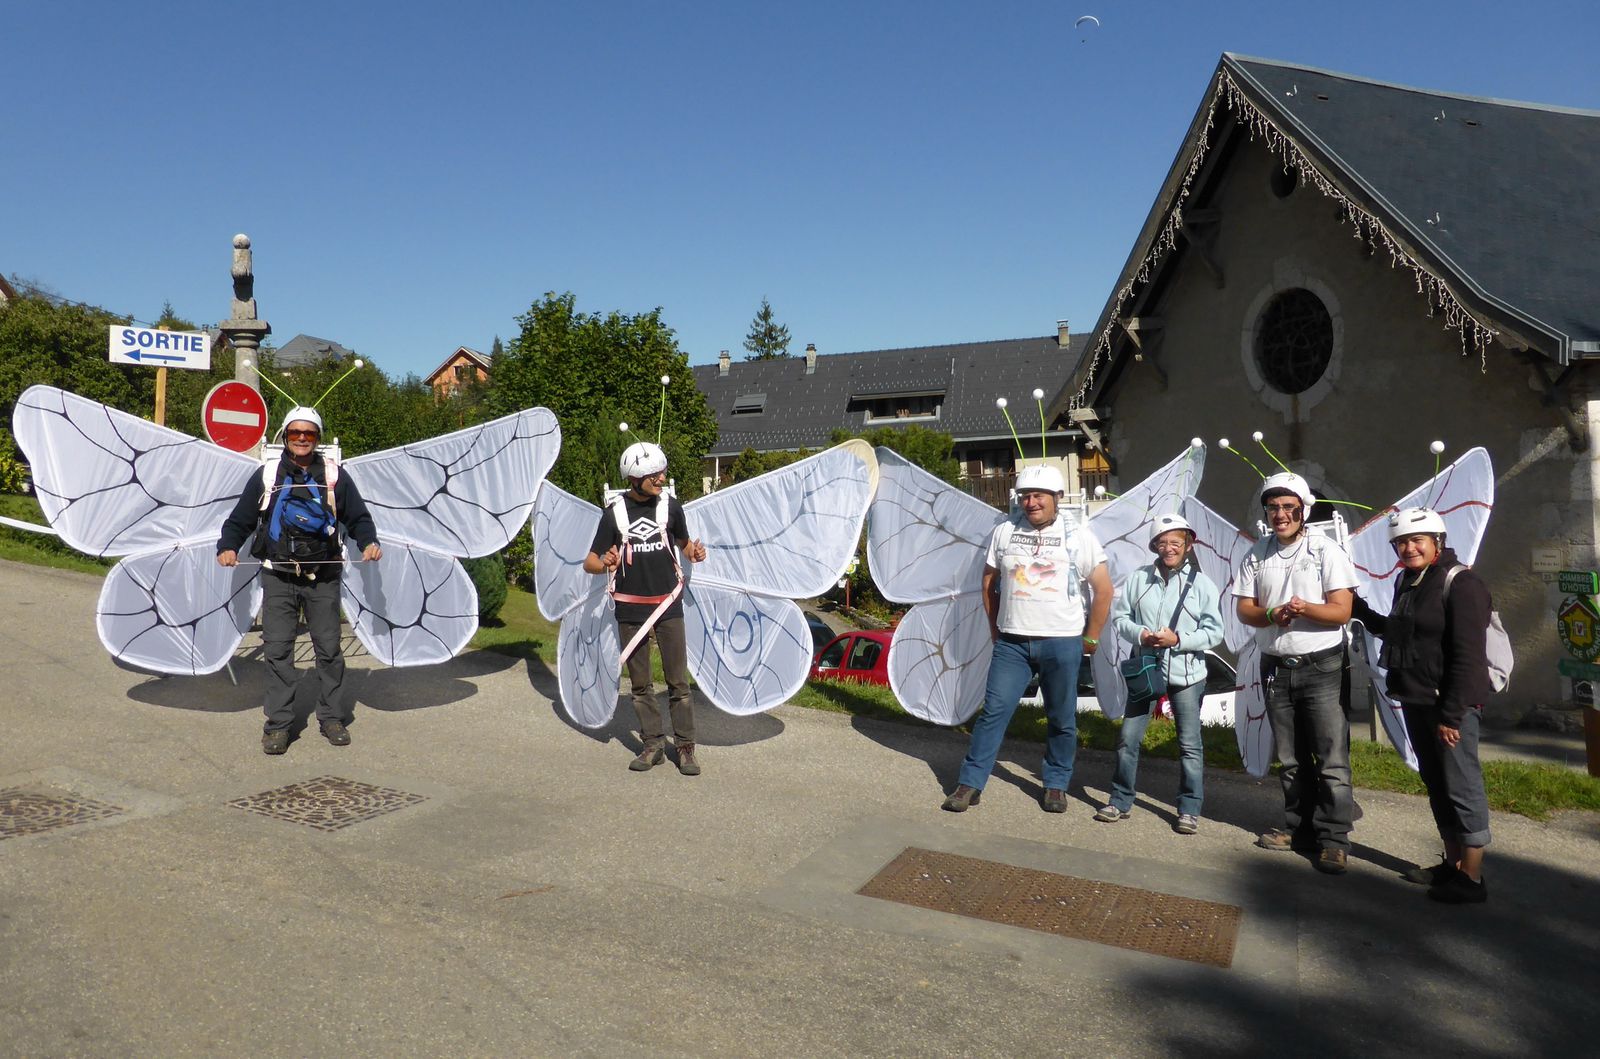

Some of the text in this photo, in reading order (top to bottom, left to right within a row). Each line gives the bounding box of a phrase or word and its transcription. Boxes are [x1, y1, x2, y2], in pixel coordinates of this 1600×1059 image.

[121, 329, 203, 352] SORTIE
[632, 541, 664, 553] mbro
[1559, 572, 1594, 584] CHAMBRES
